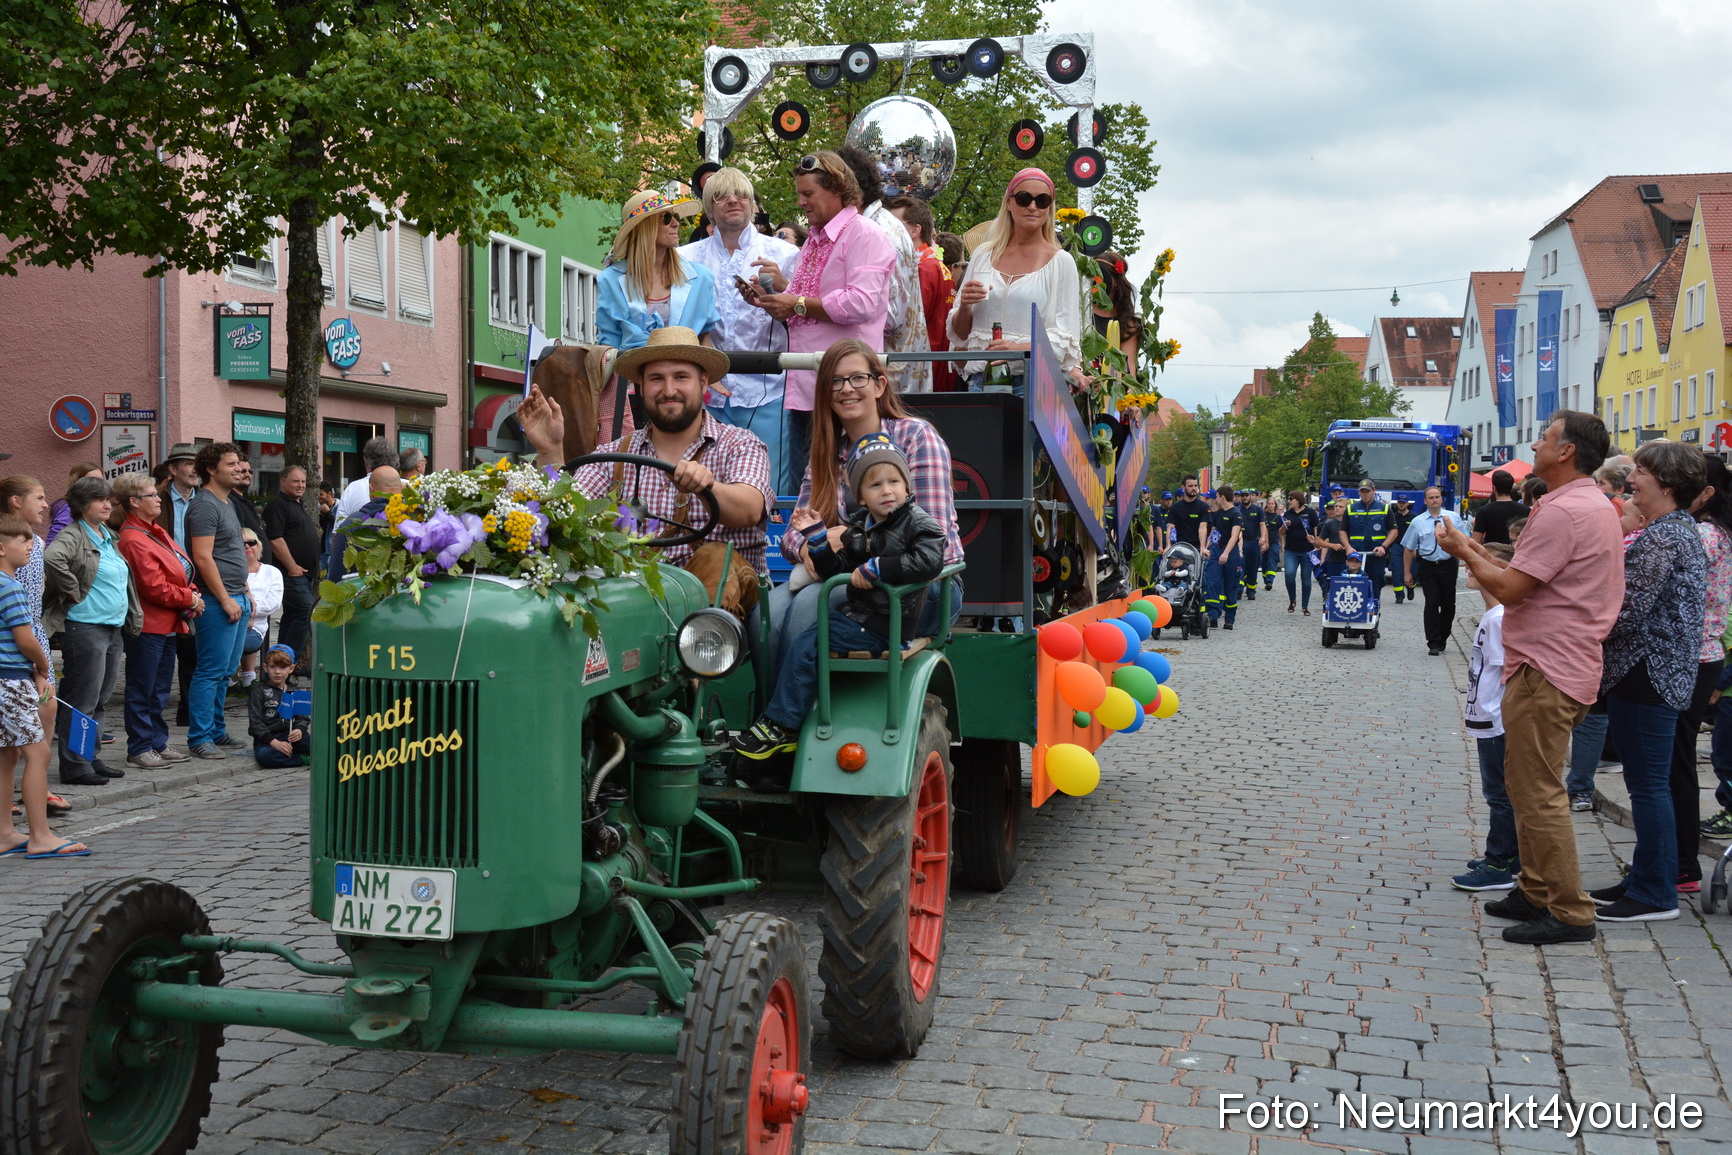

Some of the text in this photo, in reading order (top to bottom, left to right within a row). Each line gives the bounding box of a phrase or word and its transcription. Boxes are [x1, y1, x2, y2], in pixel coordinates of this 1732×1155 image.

[226, 326, 246, 339] vom
[233, 330, 262, 349] FASS
[323, 323, 345, 342] vom
[331, 335, 361, 362] FASS
[1540, 340, 1552, 371] K&L
[1626, 369, 1642, 386] HOTEL
[106, 410, 155, 420] Bockwirtsgasse
[234, 419, 271, 436] Spirituosen
[1360, 421, 1403, 429] NEUMARKT
[328, 433, 352, 446] Feinkost
[418, 436, 425, 449] Öl
[104, 459, 148, 480] VENEZIA
[336, 697, 415, 744] Fendt
[337, 728, 463, 783] Dieselross
[341, 883, 348, 893] D
[353, 869, 390, 900] NM
[339, 899, 443, 935] AW 272
